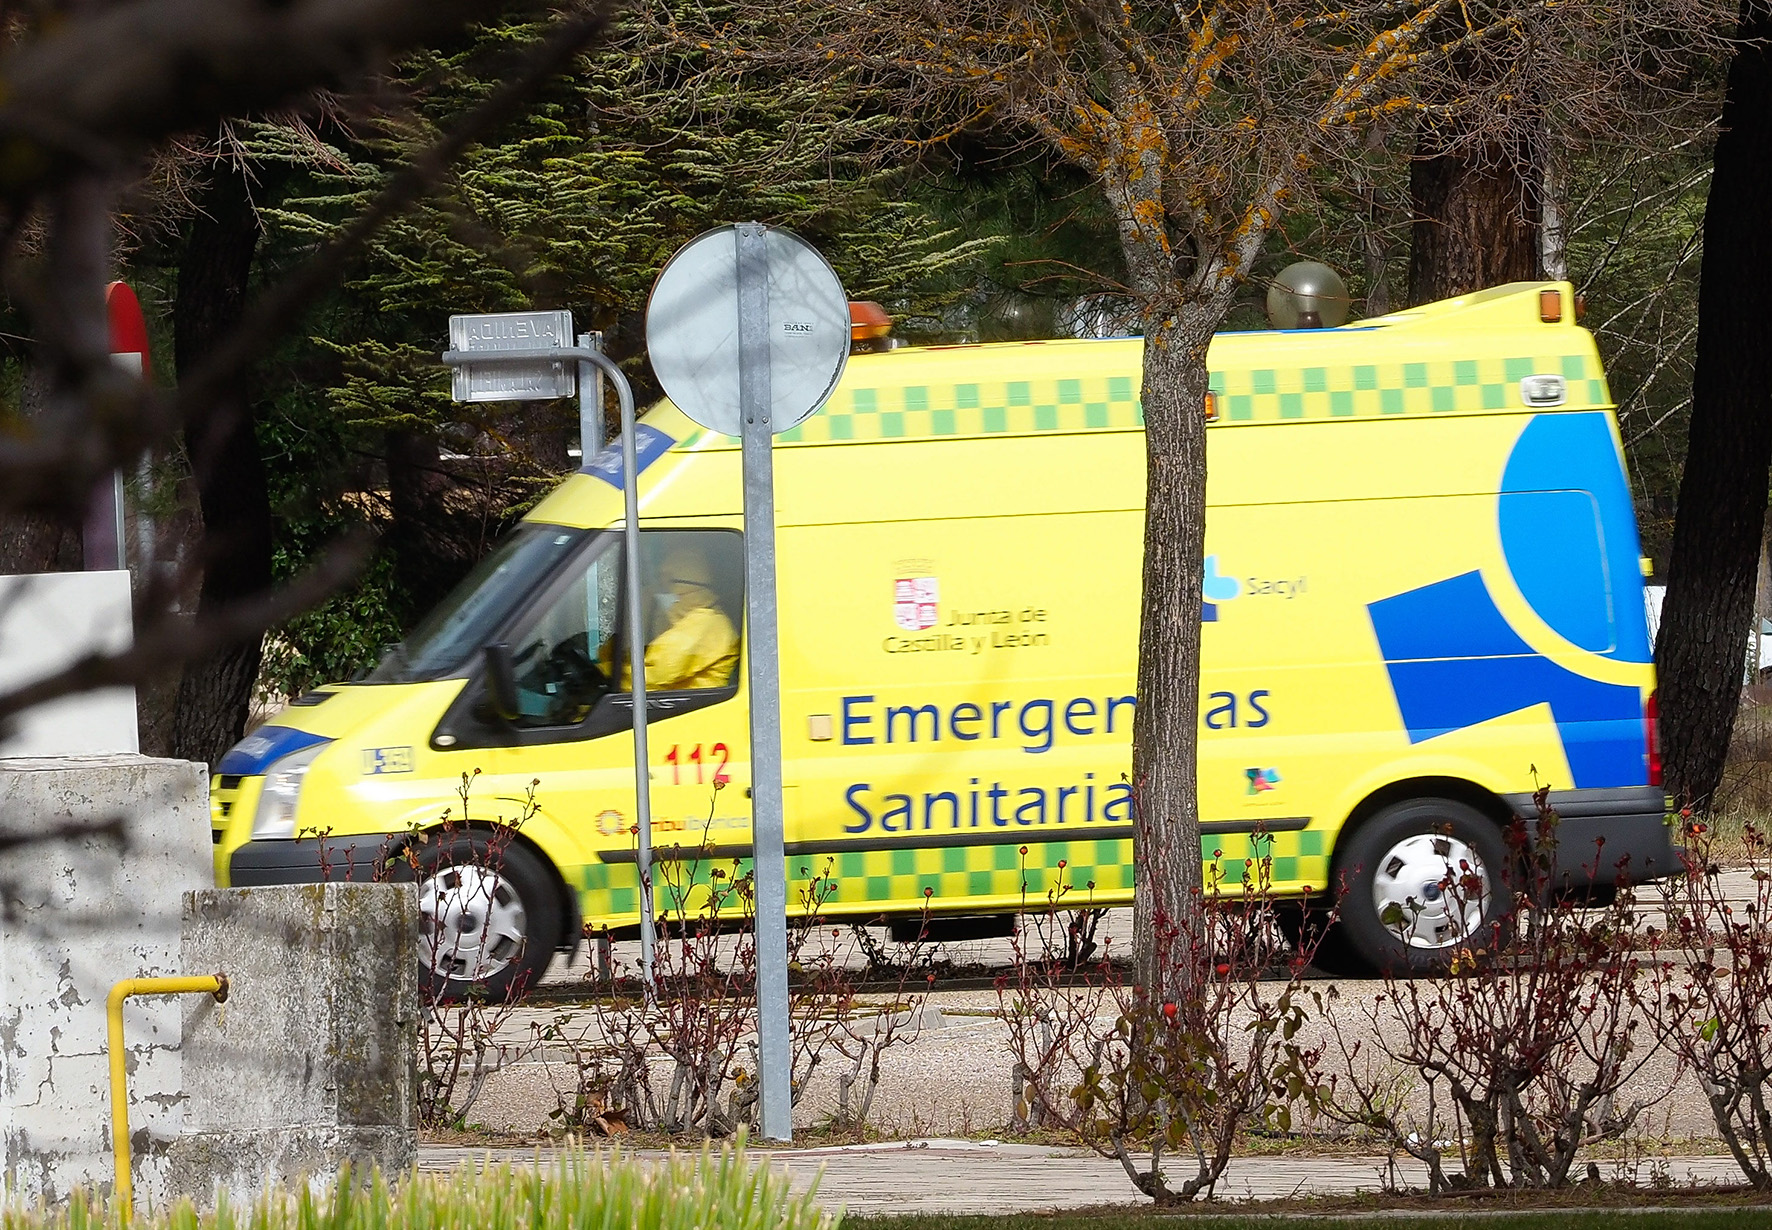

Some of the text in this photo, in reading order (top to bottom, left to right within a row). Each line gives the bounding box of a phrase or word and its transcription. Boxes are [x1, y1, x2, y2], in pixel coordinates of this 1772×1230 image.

[1246, 576, 1307, 599] Sacyl
[946, 606, 1048, 626] Junta de
[882, 630, 1049, 655] Castilla y León
[842, 689, 1270, 753] Emergenas
[664, 742, 731, 786] 112
[845, 772, 1134, 833] Sanitaria
